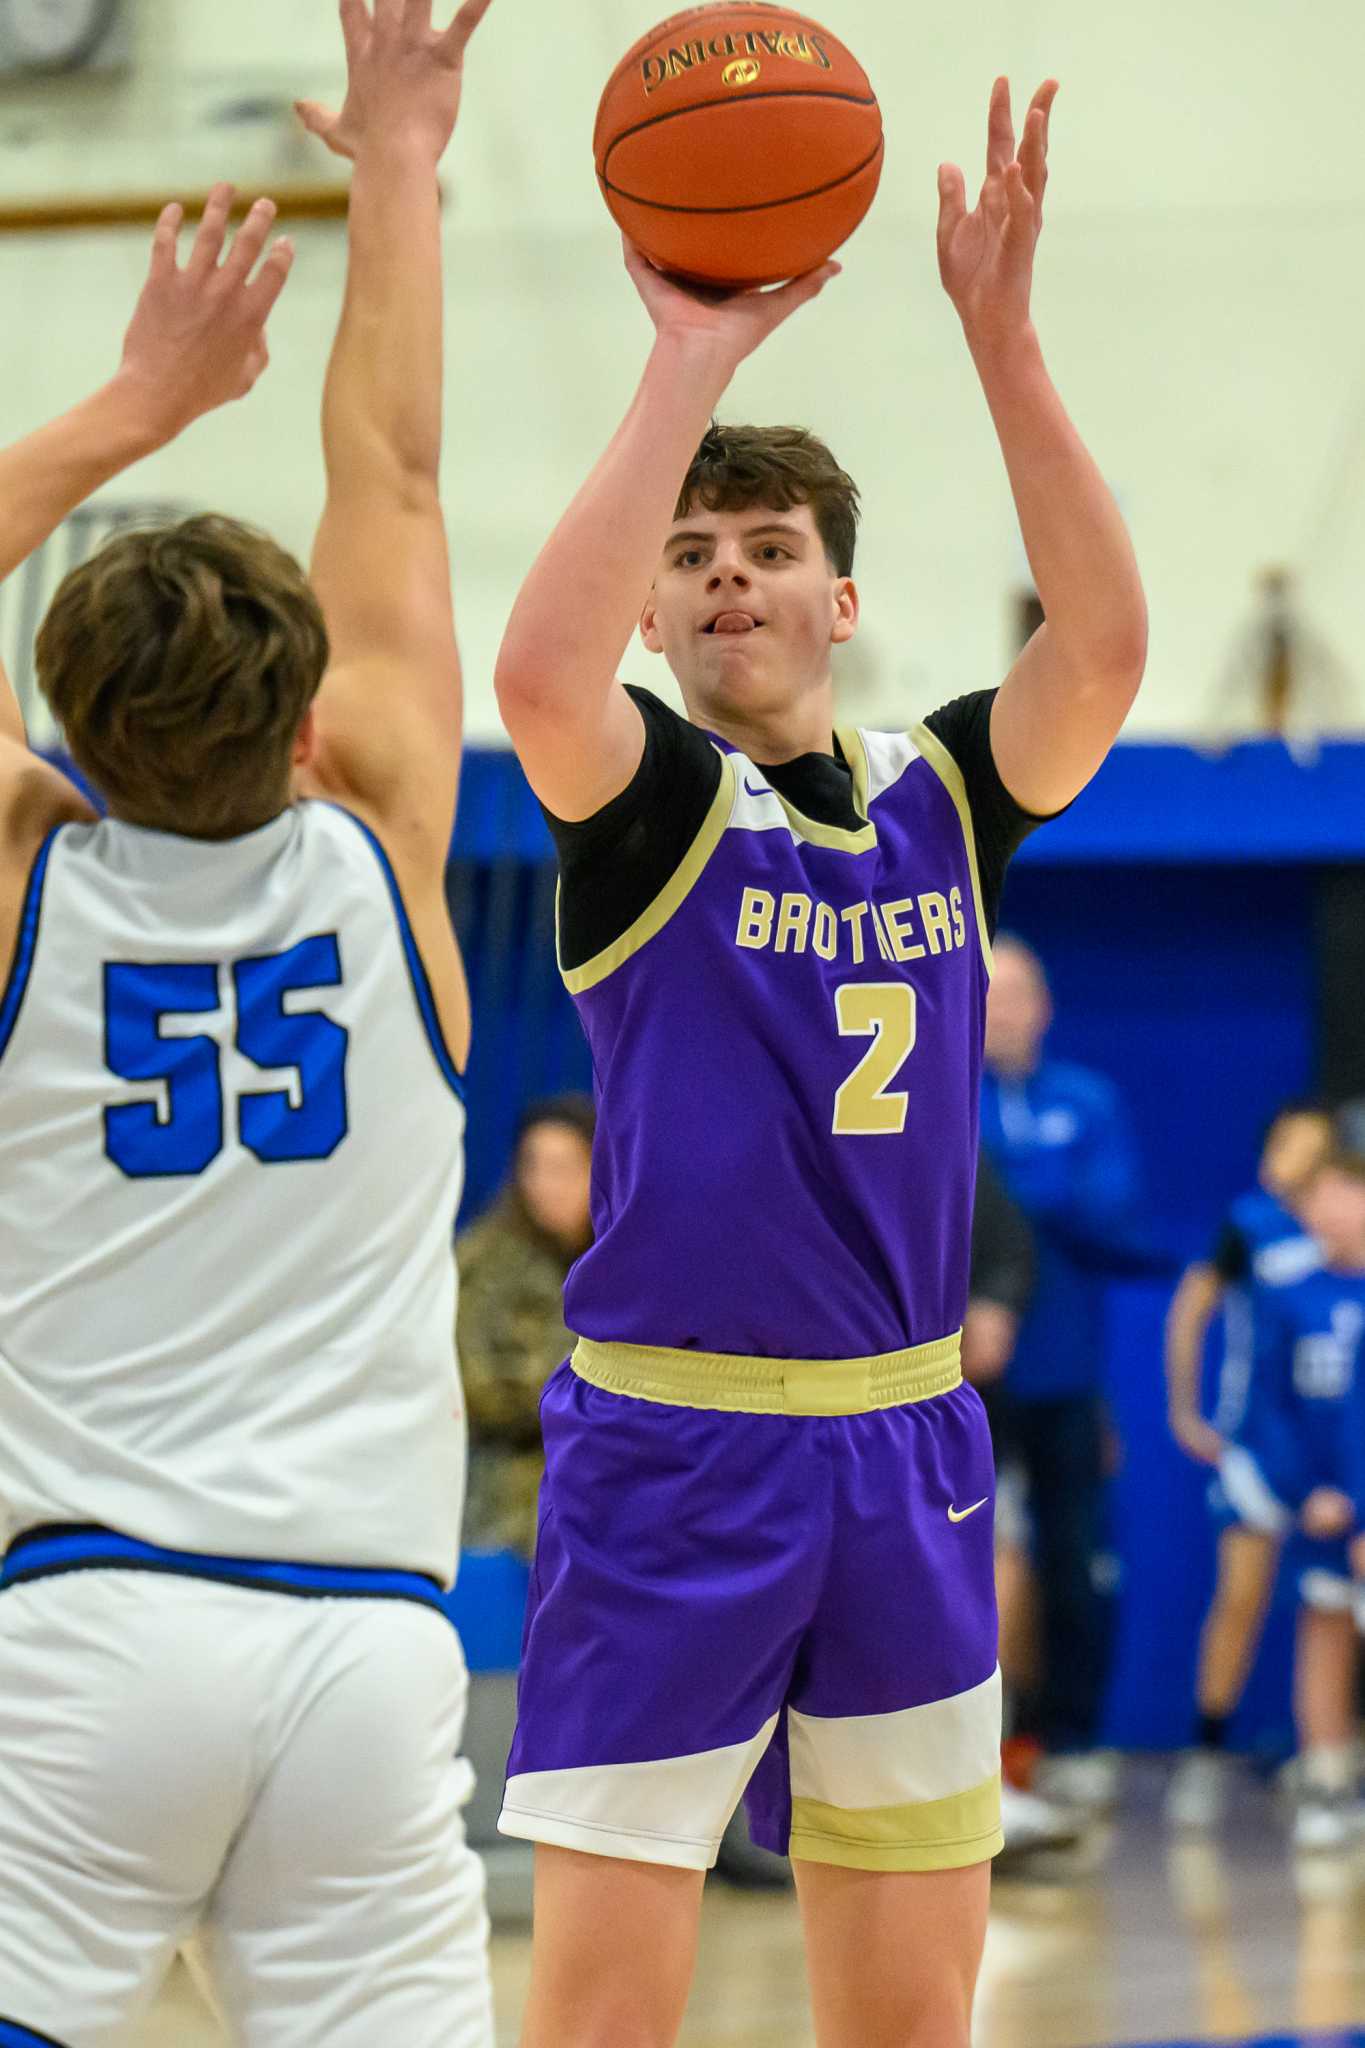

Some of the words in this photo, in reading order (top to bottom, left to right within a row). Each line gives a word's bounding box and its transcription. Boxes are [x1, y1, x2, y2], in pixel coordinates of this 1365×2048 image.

[641, 31, 832, 97] SPALDING
[103, 932, 349, 1178] 55
[832, 982, 916, 1135] 2
